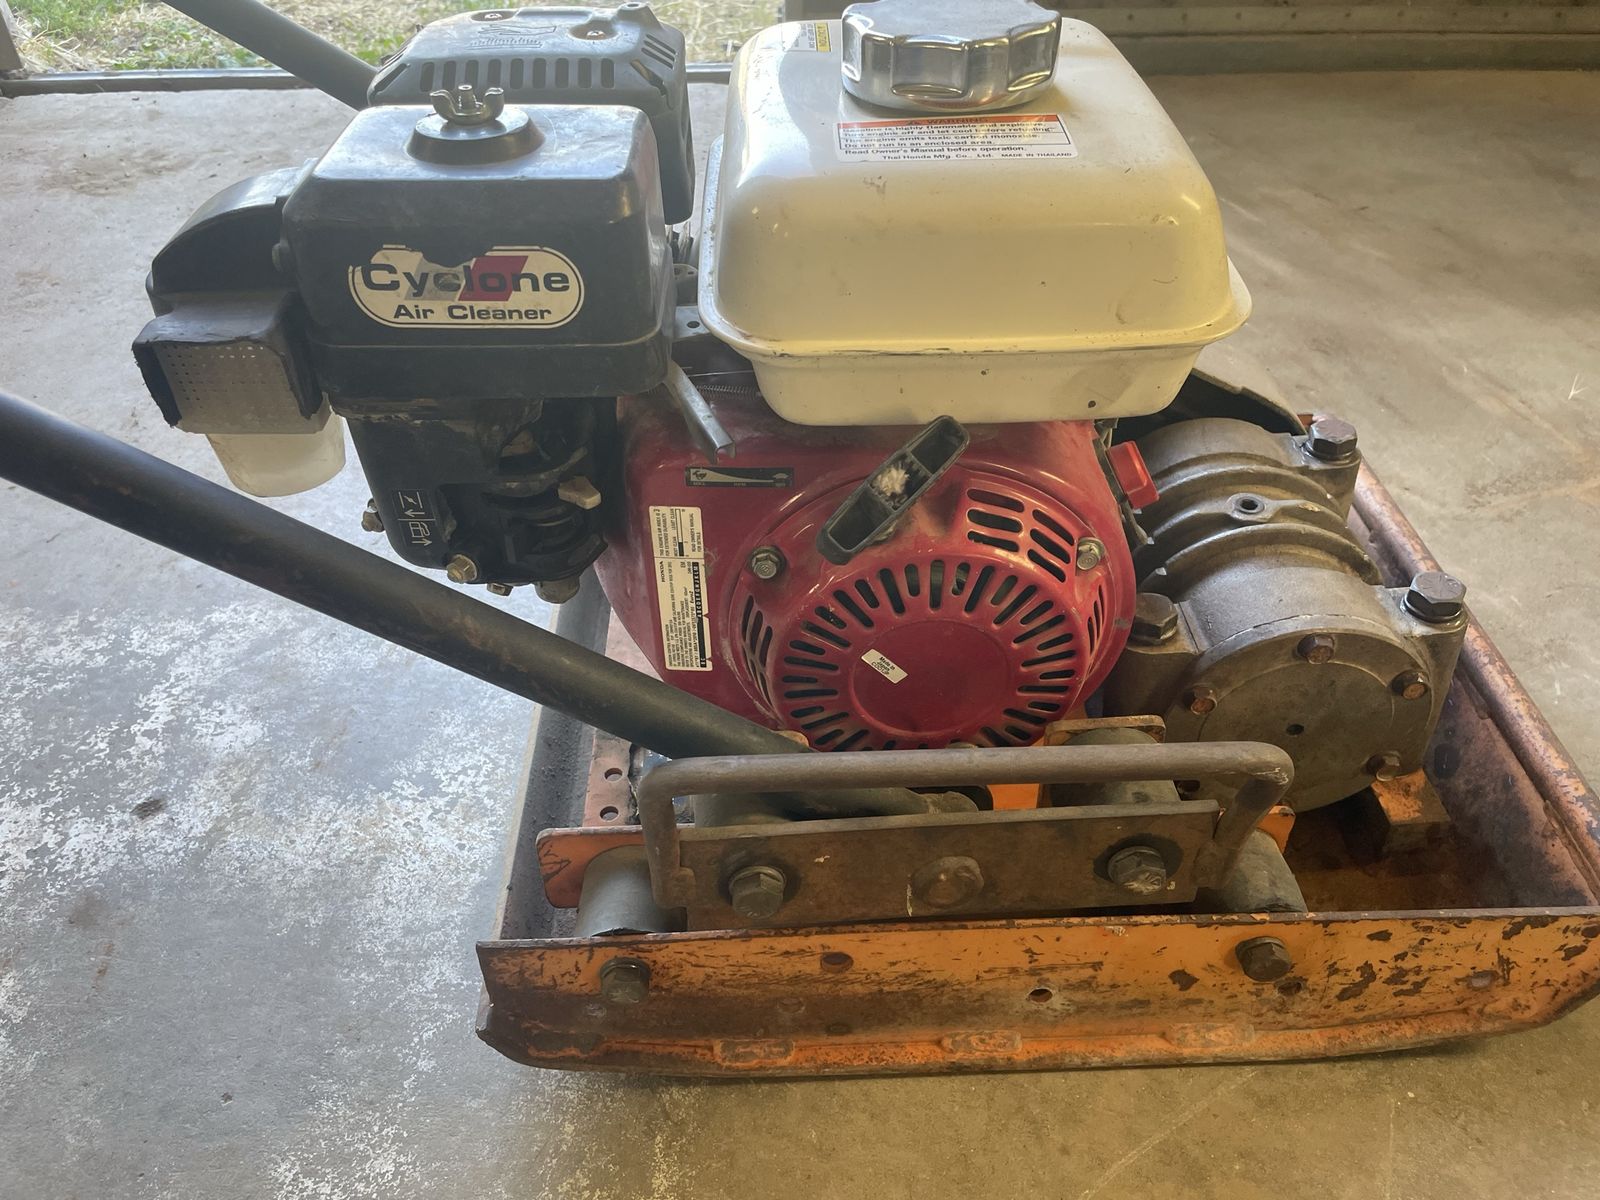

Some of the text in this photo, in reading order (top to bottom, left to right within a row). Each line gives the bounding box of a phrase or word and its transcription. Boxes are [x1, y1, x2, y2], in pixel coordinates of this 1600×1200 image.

[361, 262, 570, 297] Cyclone
[394, 304, 552, 320] Air Cleaner
